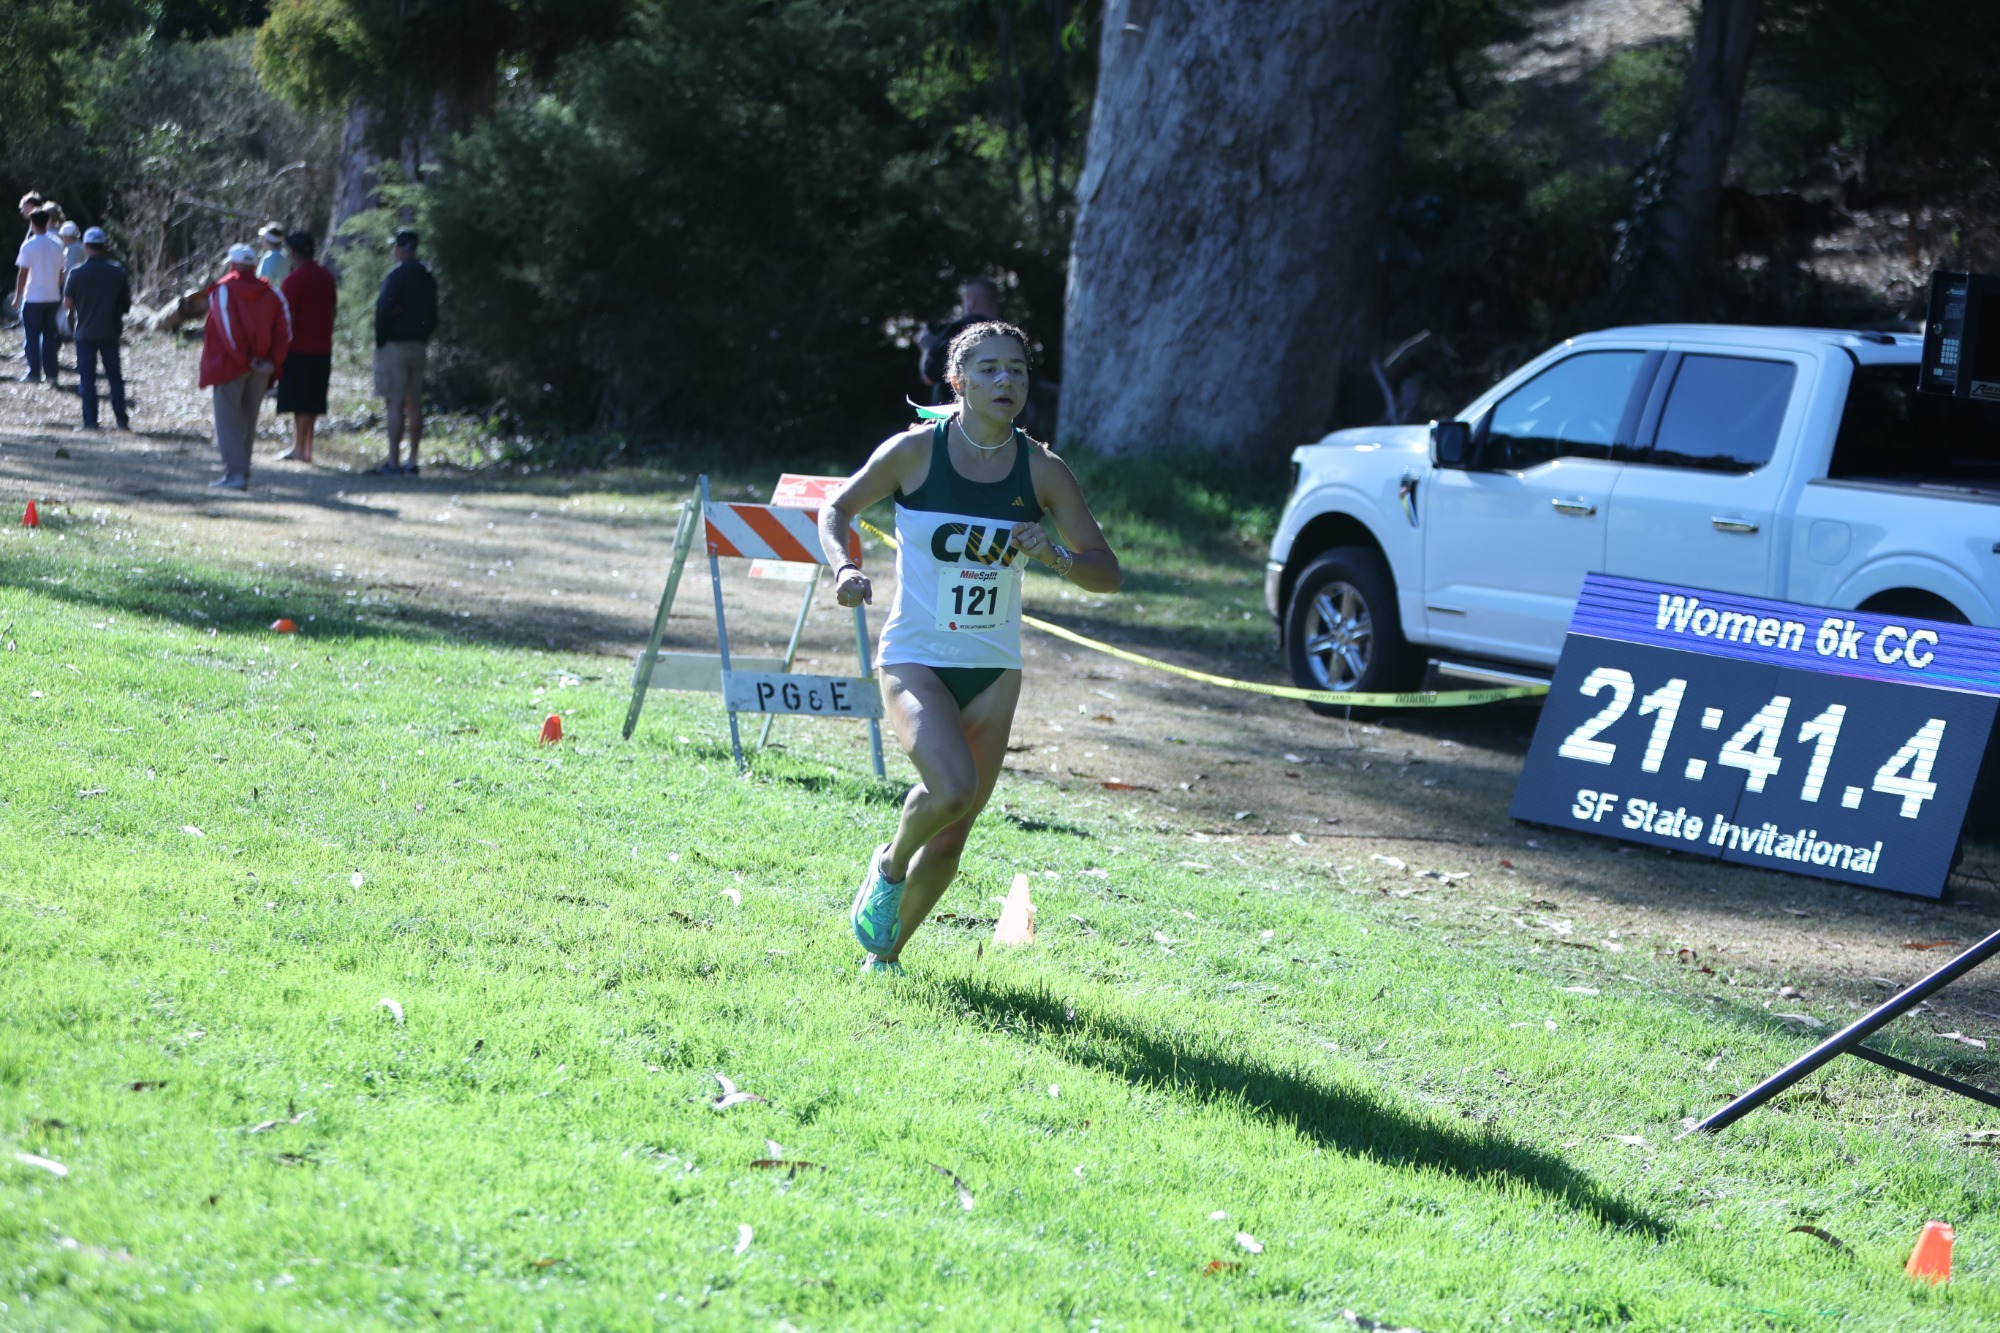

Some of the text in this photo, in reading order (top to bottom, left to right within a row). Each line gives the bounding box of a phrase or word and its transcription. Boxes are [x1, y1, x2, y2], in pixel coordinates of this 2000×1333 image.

[951, 585, 998, 615] 121
[960, 570, 998, 581] MileSplit
[1656, 592, 1939, 669] Women 6k CC
[756, 681, 852, 712] PG&E
[1557, 666, 1947, 820] 21:41.4
[1571, 788, 1884, 874] SF State Invitational
